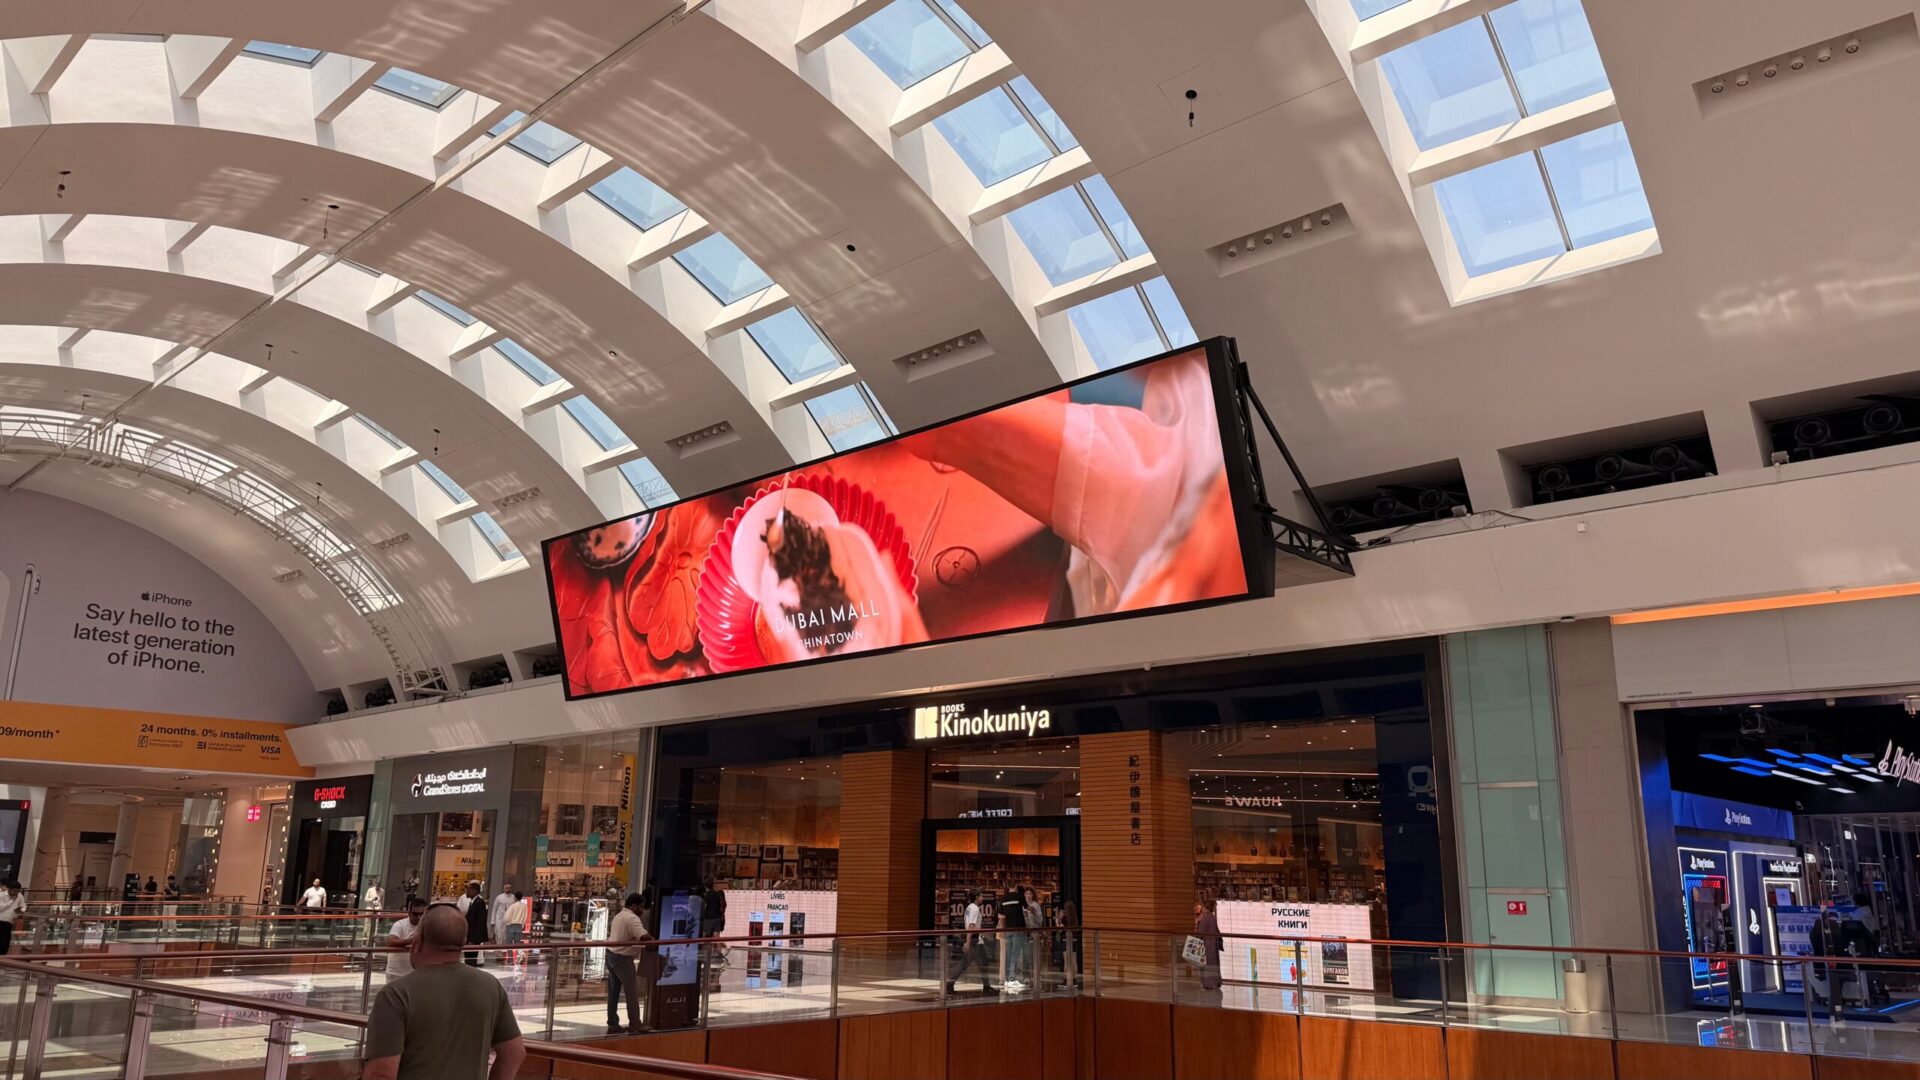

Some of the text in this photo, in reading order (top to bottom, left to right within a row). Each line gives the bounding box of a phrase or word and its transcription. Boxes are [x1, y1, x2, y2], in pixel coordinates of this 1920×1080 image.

[151, 592, 193, 607] iPhone
[85, 603, 235, 636] Say hello to the
[774, 600, 880, 633] DUBAI MALL
[73, 623, 235, 656] latest generation
[797, 630, 863, 649] CHINATOWN
[107, 650, 205, 674] of iPhone.
[941, 703, 965, 713] BOOKS
[940, 705, 1050, 737] Kinokuniya
[141, 724, 282, 742] 24 months. 0% installments.
[260, 745, 281, 754] VISA
[314, 786, 346, 801] G-SHOCK
[461, 782, 486, 794] DIGITAL
[621, 766, 631, 811] Nikon
[321, 800, 337, 809] CASIO
[616, 821, 627, 866] Nikon
[767, 903, 789, 911] FRANÇAIS
[1271, 908, 1310, 917] РУССКИЕ
[1278, 920, 1308, 929] КНИГИ
